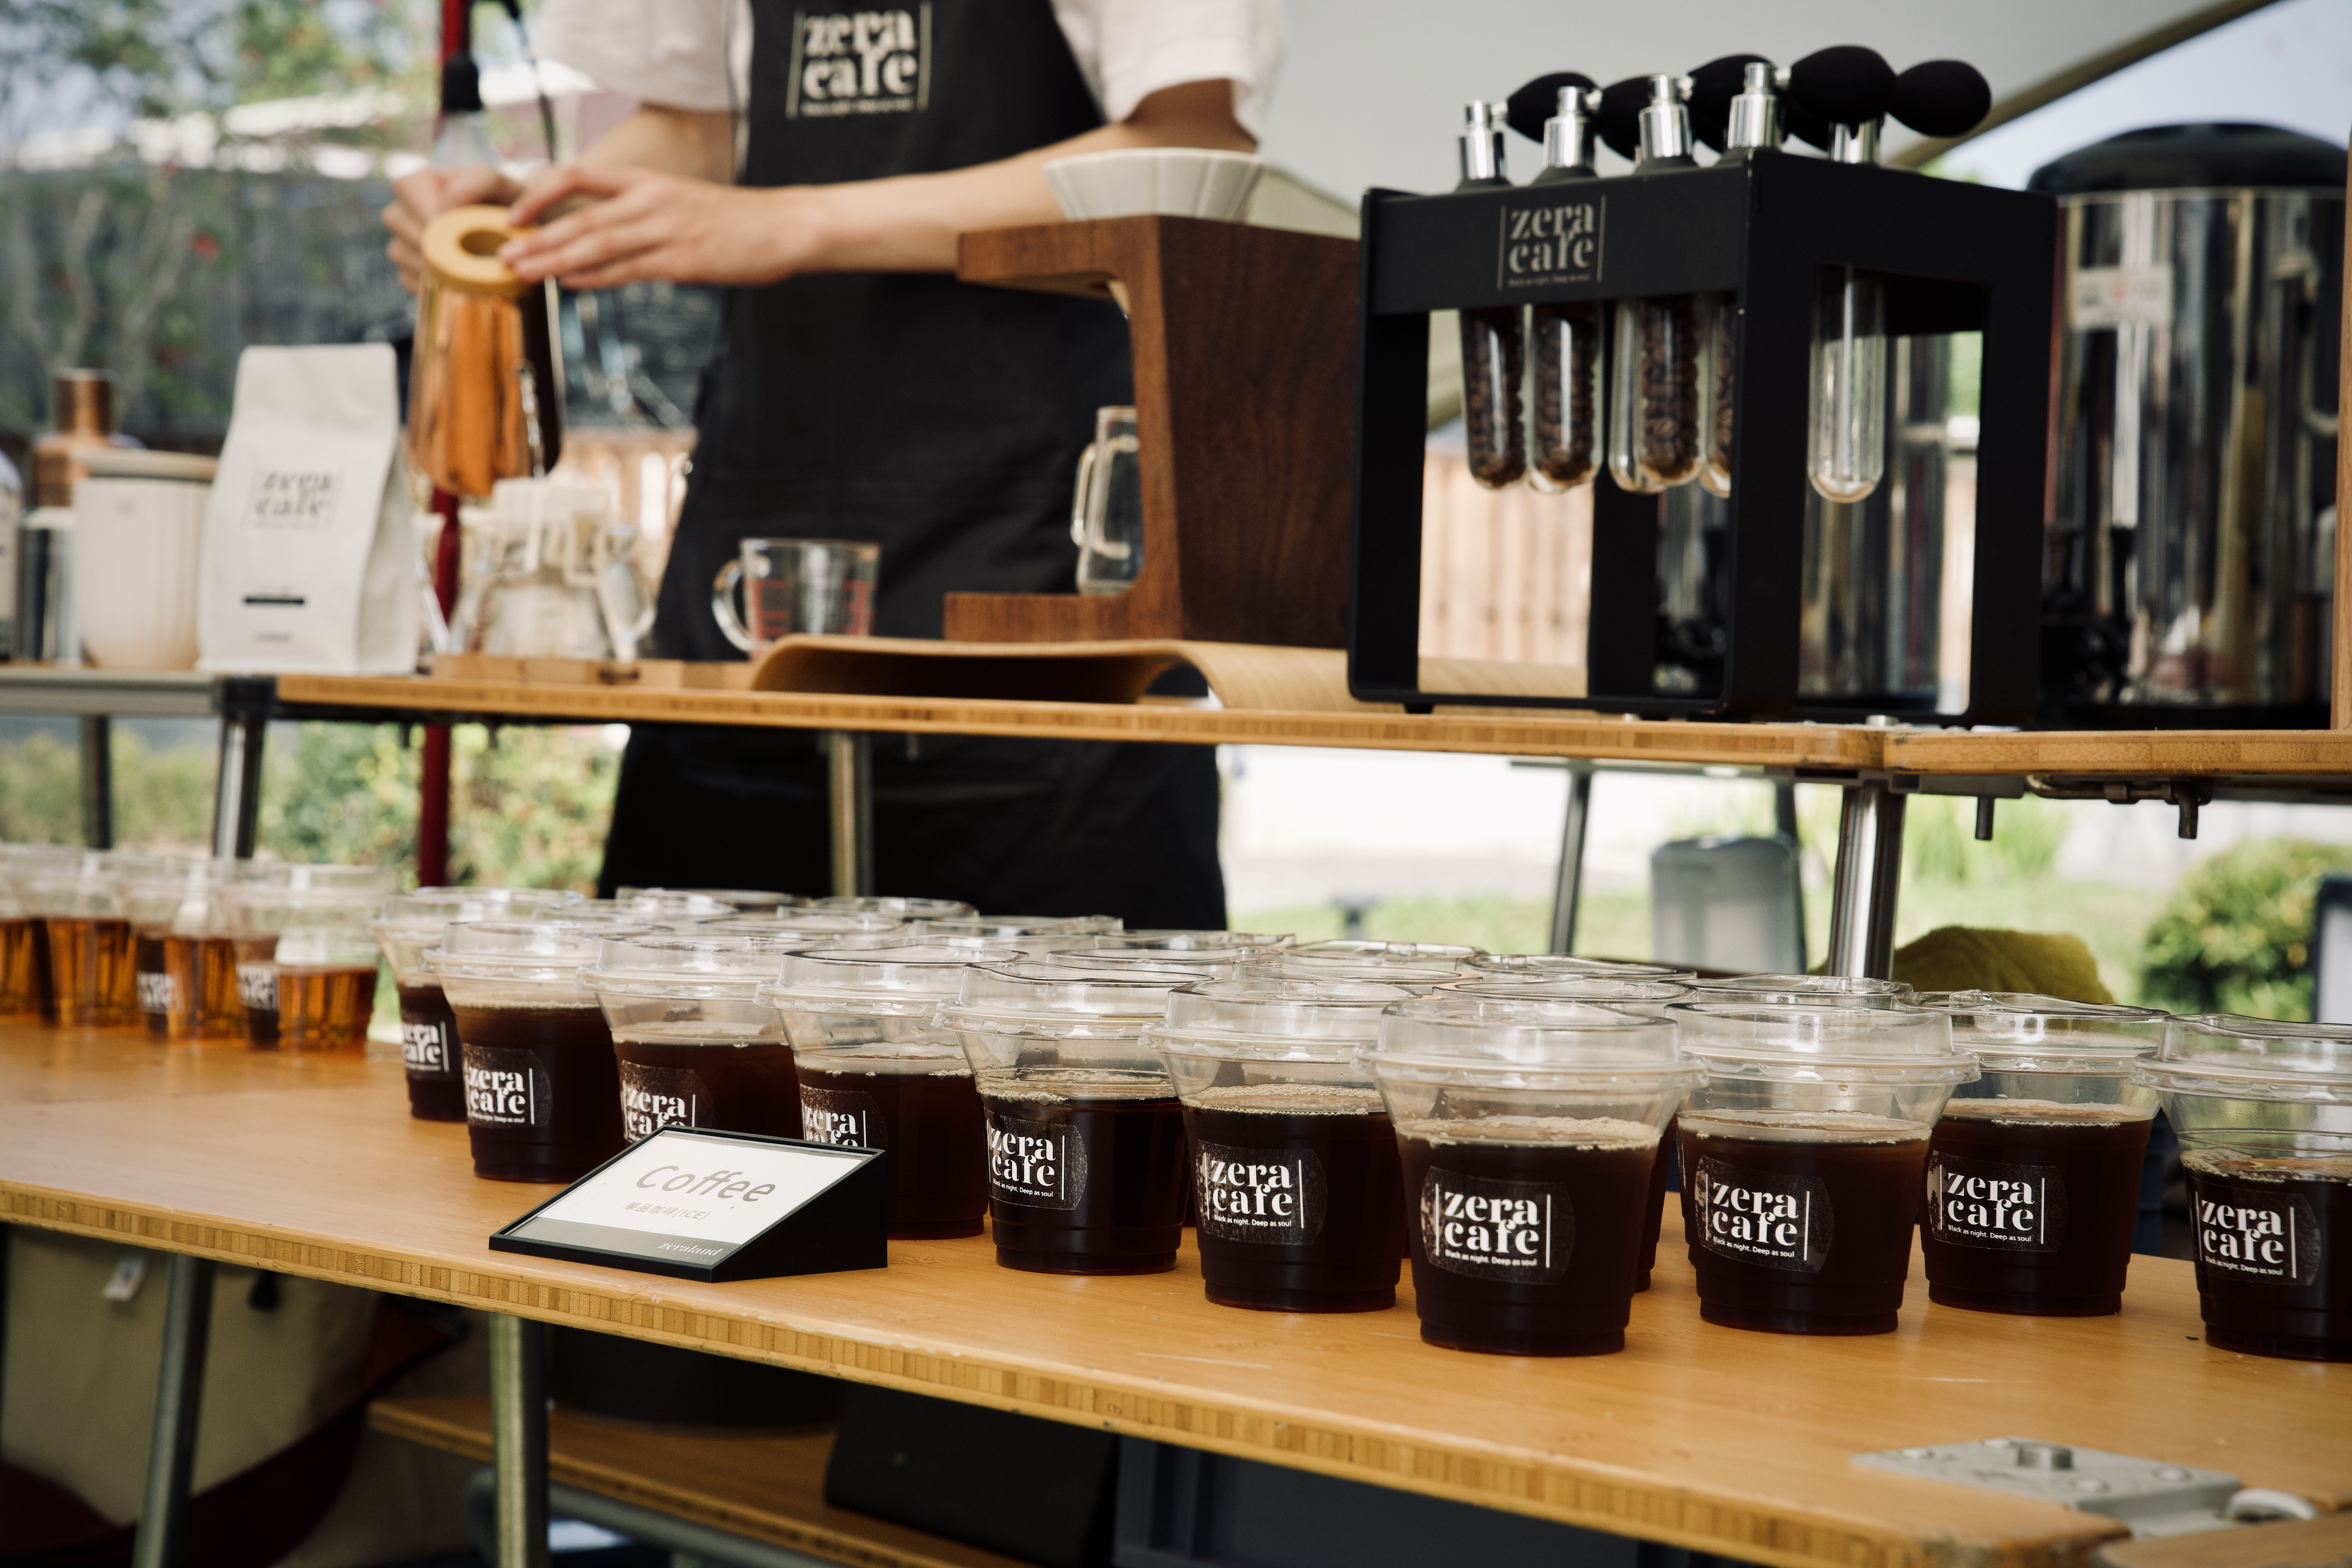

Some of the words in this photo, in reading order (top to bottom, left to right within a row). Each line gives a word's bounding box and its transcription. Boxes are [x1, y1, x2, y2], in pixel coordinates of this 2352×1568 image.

[1510, 203, 1594, 240] zera
[1508, 231, 1594, 273] cafe
[469, 1066, 526, 1092] zera
[470, 1087, 526, 1114] cafe
[627, 1088, 687, 1117] zera
[804, 1106, 858, 1134] zera
[991, 1128, 1056, 1161] zera
[636, 1165, 776, 1202] Coffee
[992, 1155, 1055, 1186] cafe
[1211, 1160, 1292, 1188] zera
[1020, 1187, 1033, 1195] Deep
[1212, 1183, 1292, 1216] cafe
[1713, 1182, 1799, 1219] zera
[1948, 1172, 2035, 1205] zera
[623, 1202, 711, 1221] 單品咖啡(ICE)
[1214, 1214, 1226, 1222] Black
[1234, 1218, 1250, 1226] night.
[1252, 1219, 1269, 1227] Deep
[1444, 1192, 1540, 1225] zera
[1948, 1199, 2034, 1231] cafe
[2201, 1200, 2285, 1235] zera
[1444, 1219, 1539, 1254] cafe
[1713, 1212, 1798, 1246] cafe
[1948, 1224, 1962, 1233] Black
[1990, 1232, 2007, 1241] Deep
[657, 1243, 723, 1256] zeraland
[1713, 1236, 1726, 1245] Black
[1733, 1243, 1751, 1252] night.
[1753, 1246, 1770, 1256] Deep
[2203, 1228, 2284, 1263] cafe
